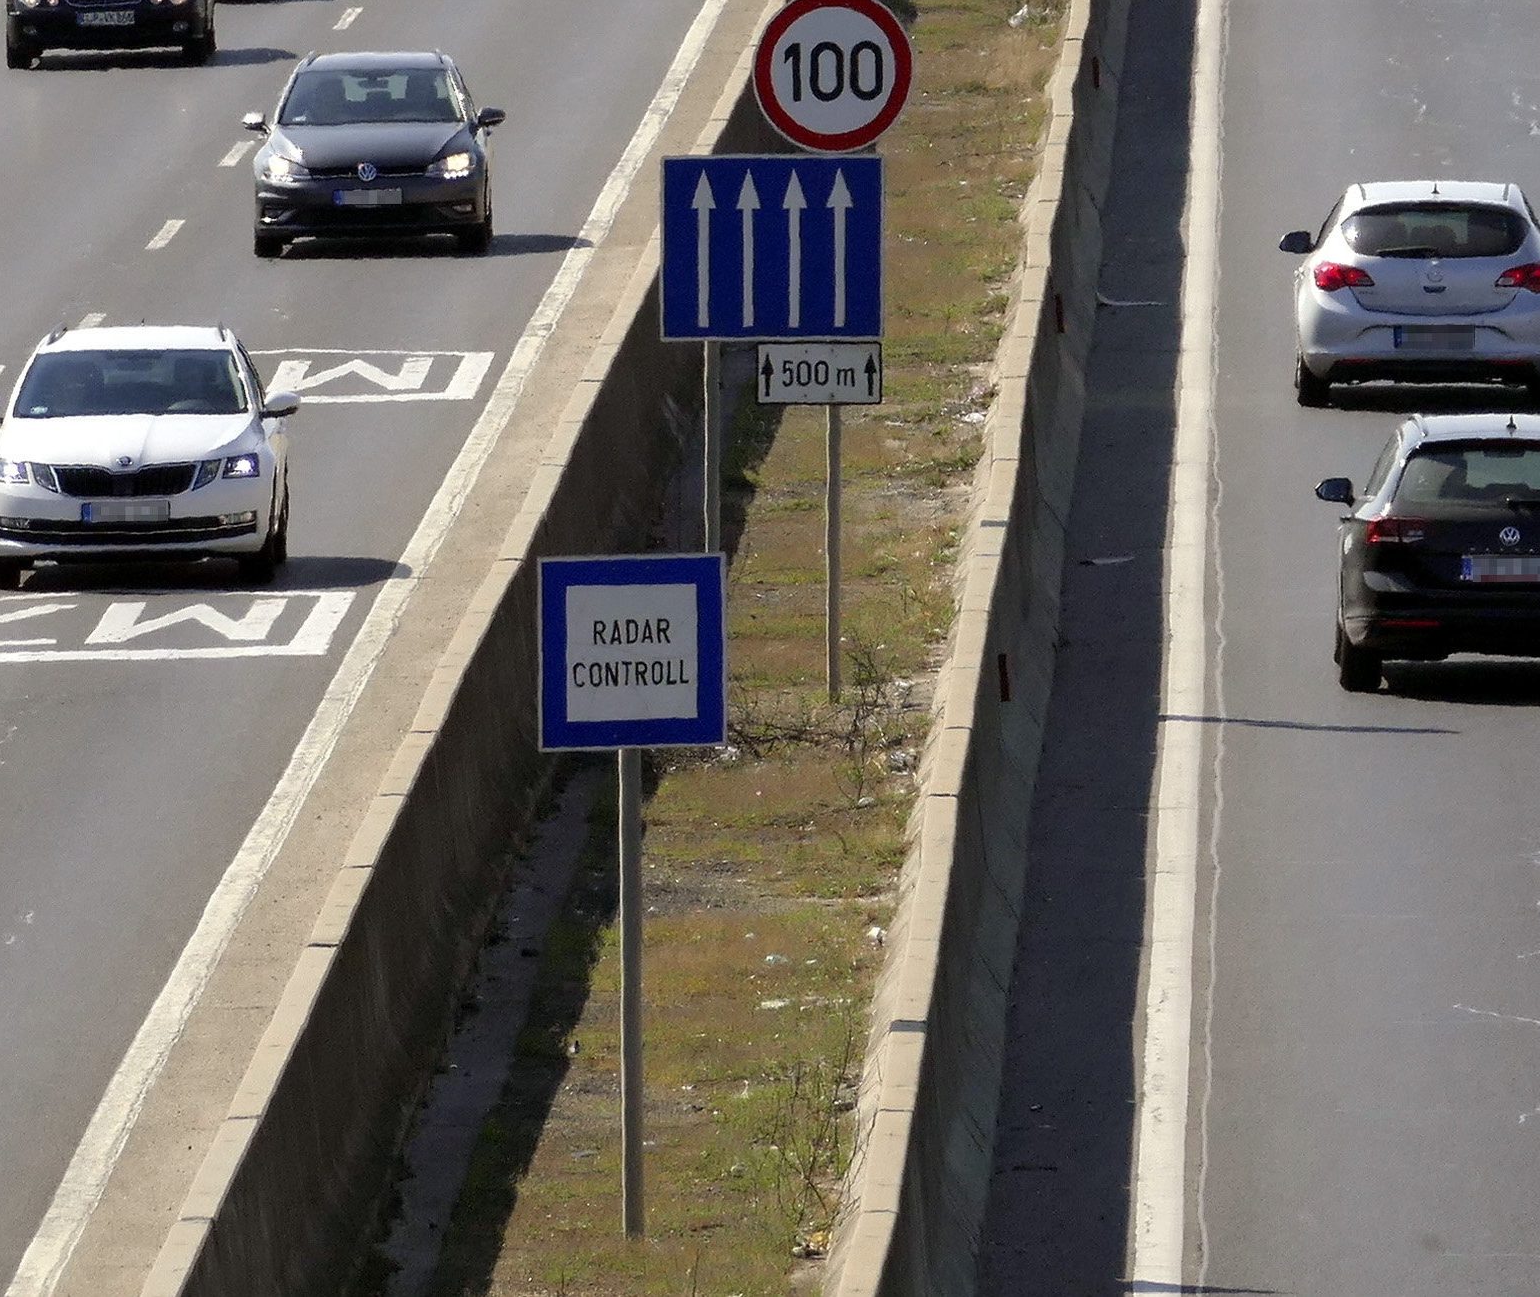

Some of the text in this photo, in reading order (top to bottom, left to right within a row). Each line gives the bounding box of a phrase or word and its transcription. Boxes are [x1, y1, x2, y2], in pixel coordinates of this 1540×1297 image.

[783, 41, 885, 103] 100
[781, 360, 857, 388] 500 m
[593, 618, 671, 645] RADAR
[572, 659, 691, 688] CONTROLL
